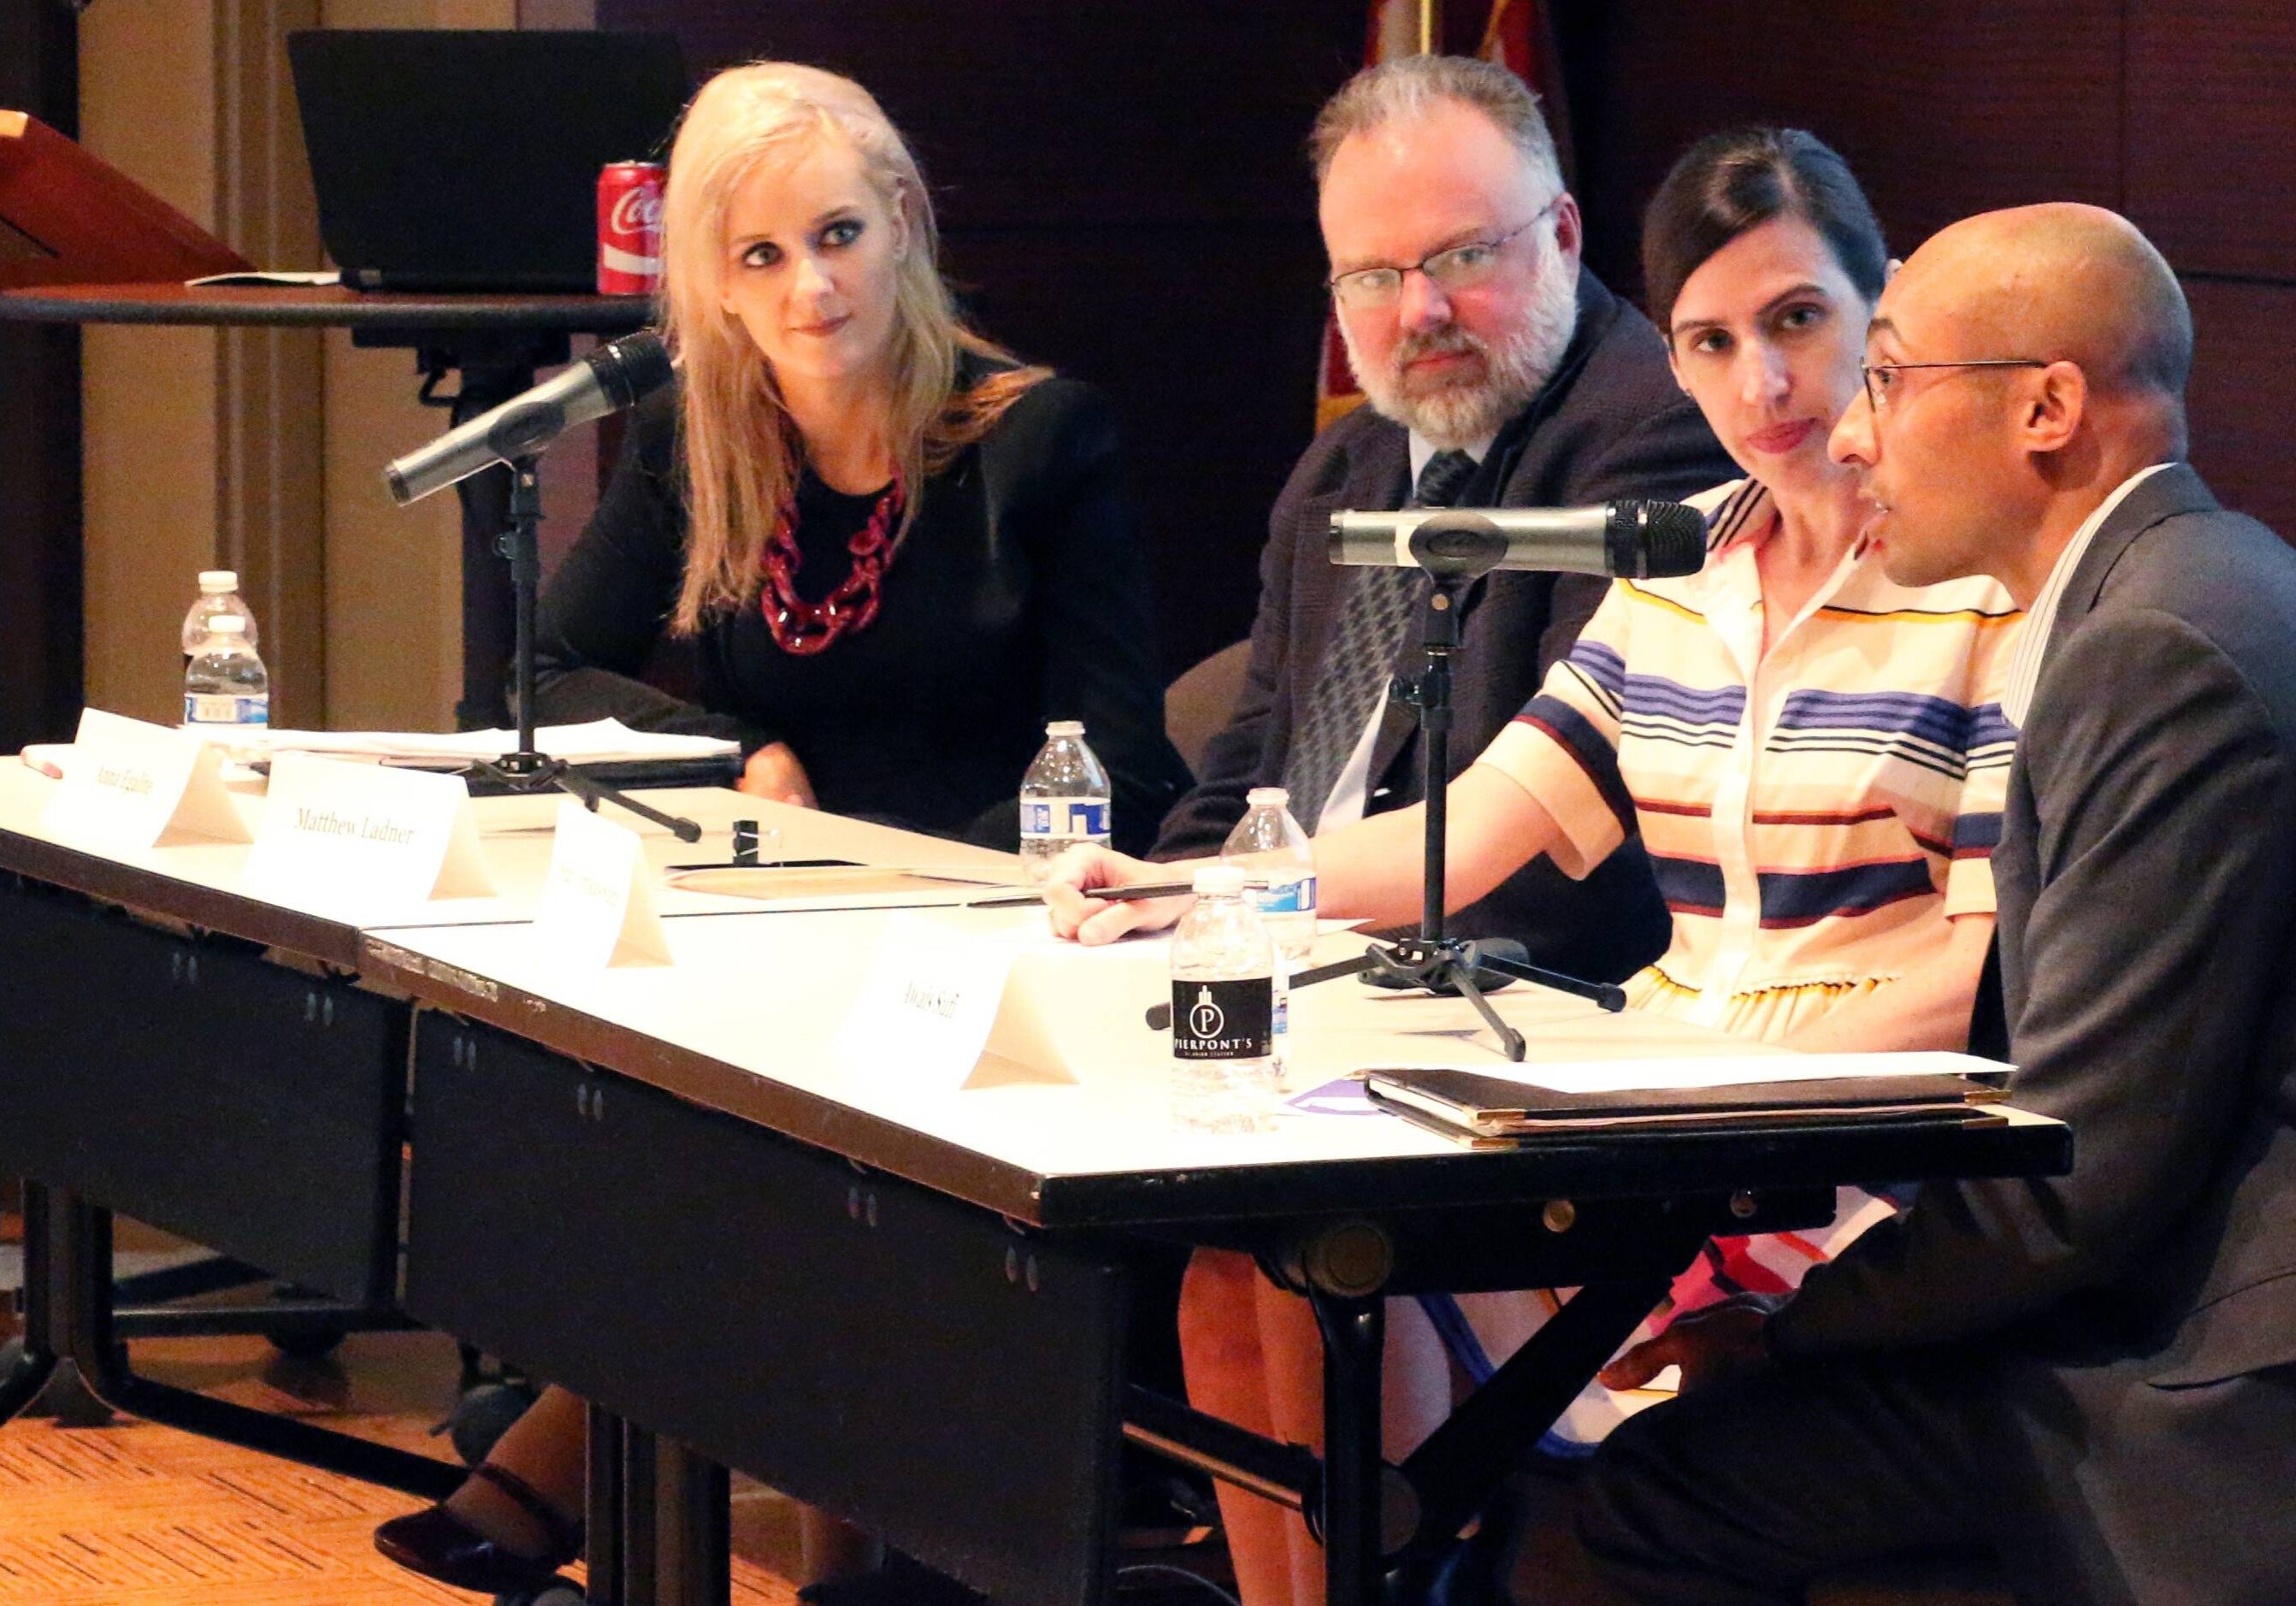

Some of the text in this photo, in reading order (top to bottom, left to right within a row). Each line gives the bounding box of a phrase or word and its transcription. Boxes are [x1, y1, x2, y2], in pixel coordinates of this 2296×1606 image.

[295, 807, 414, 844] Matthew Ladner
[1201, 1008, 1214, 1032] P
[1174, 1037, 1252, 1049] PIERPONT'S
